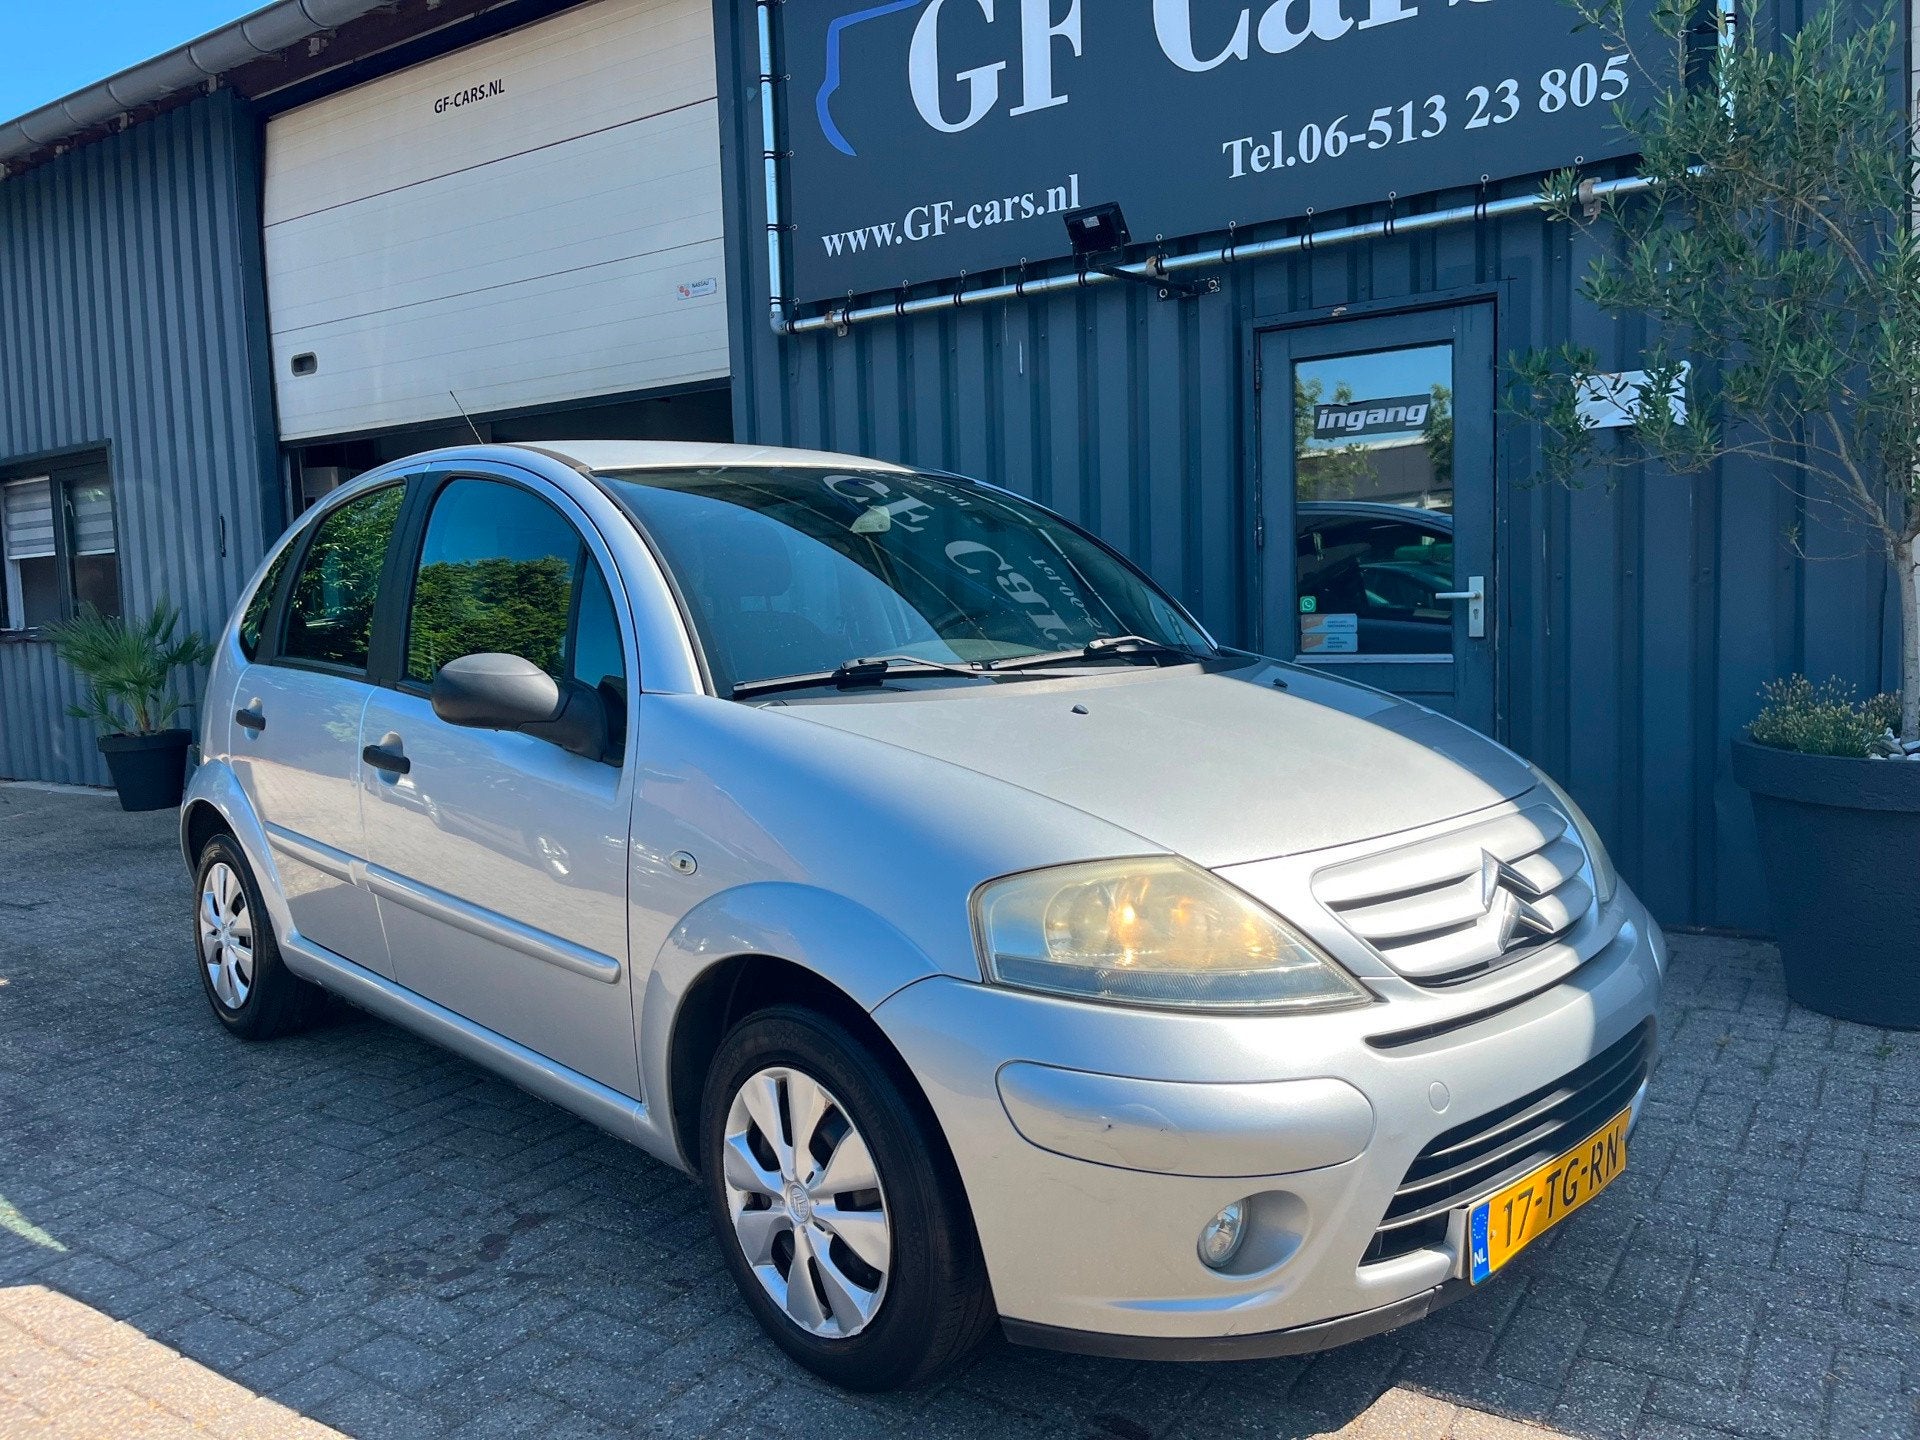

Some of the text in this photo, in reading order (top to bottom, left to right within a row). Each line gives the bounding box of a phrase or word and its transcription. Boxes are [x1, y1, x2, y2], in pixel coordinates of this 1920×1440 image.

[434, 79, 505, 114] GF-CARS.NL
[908, 0, 1082, 133] GF
[1222, 54, 1631, 179] Tel.06-513 23 805
[821, 174, 1081, 258] www.GF-cars.nl
[1317, 404, 1429, 432] ingang
[1503, 1125, 1620, 1248] 17-TG-RN
[1474, 1248, 1487, 1268] NL
